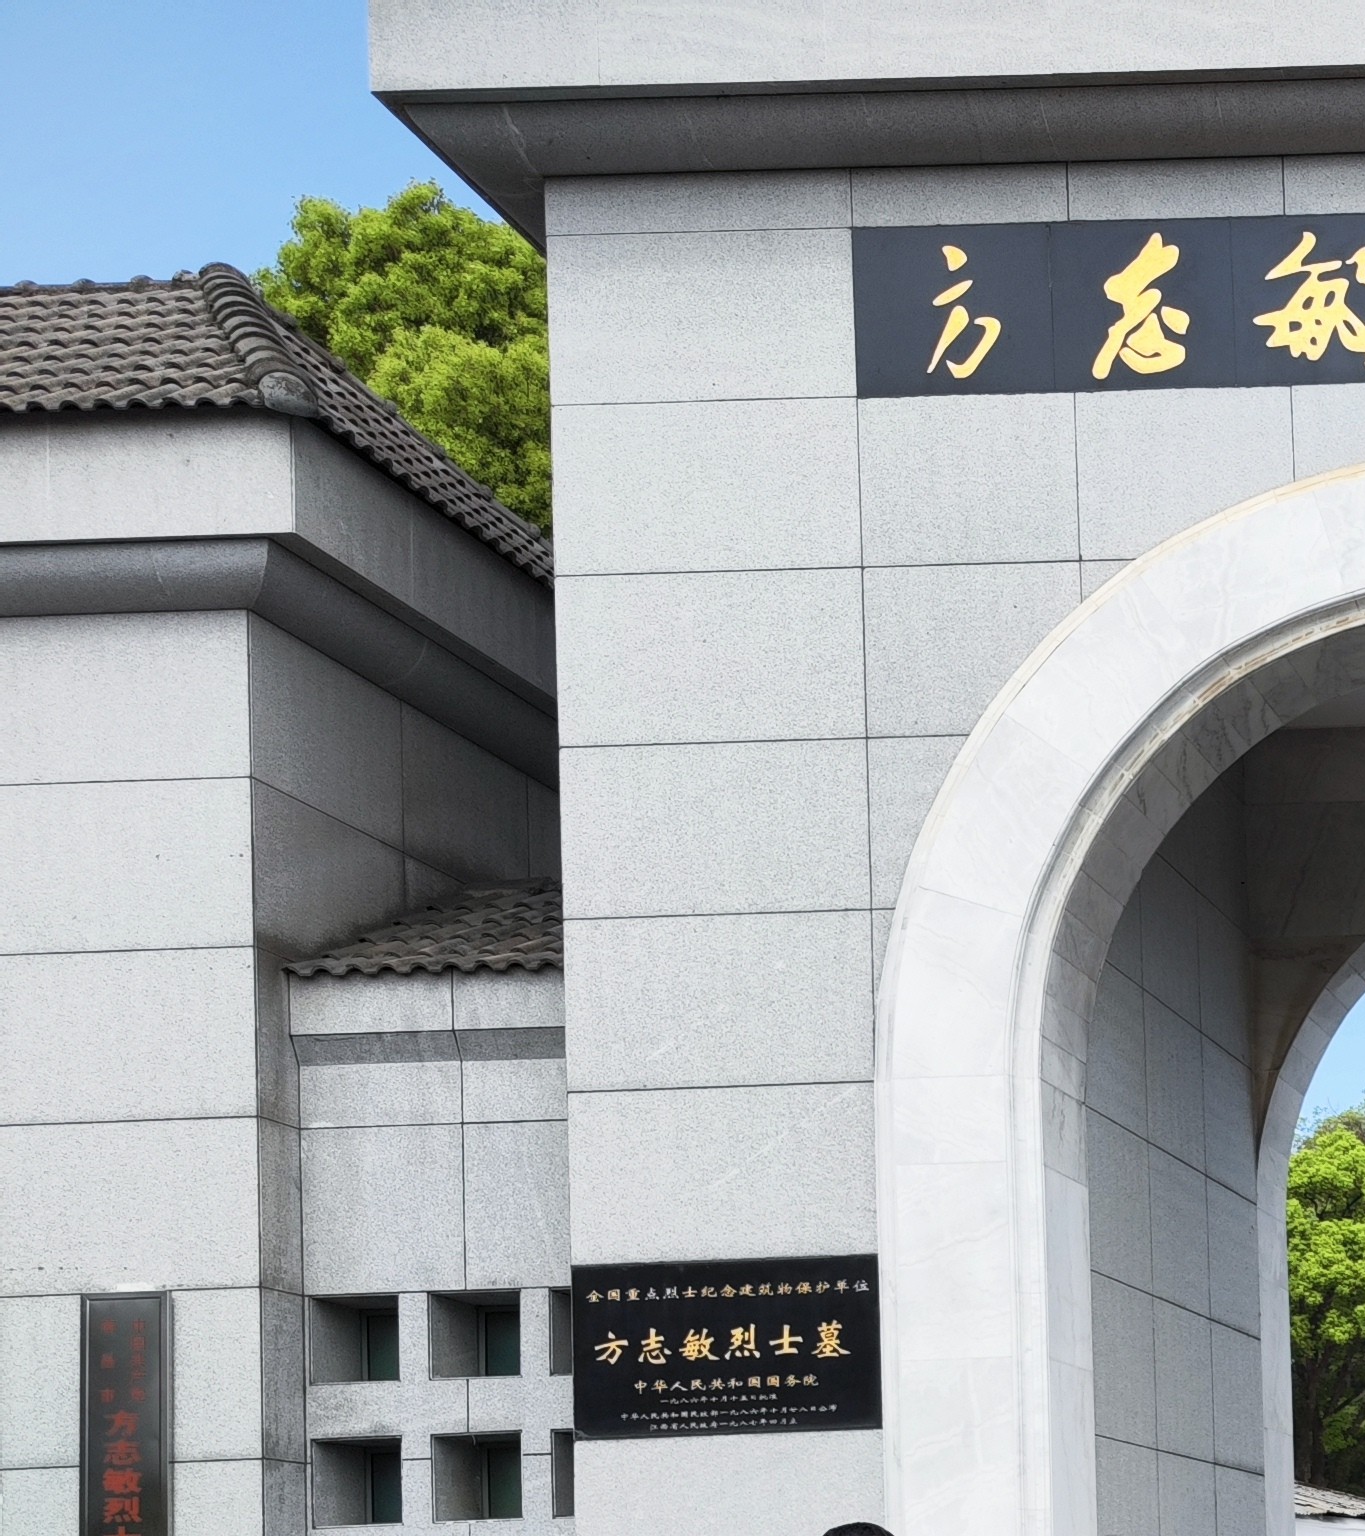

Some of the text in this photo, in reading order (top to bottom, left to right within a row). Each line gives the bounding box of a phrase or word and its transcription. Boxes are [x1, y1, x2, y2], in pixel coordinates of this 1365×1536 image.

[585, 1278, 871, 1304] 全国重点烈士纪念建筑物保护单位
[594, 1319, 852, 1366] 方志敏烈士墓
[633, 1373, 820, 1395] 中华人民共和国国务院
